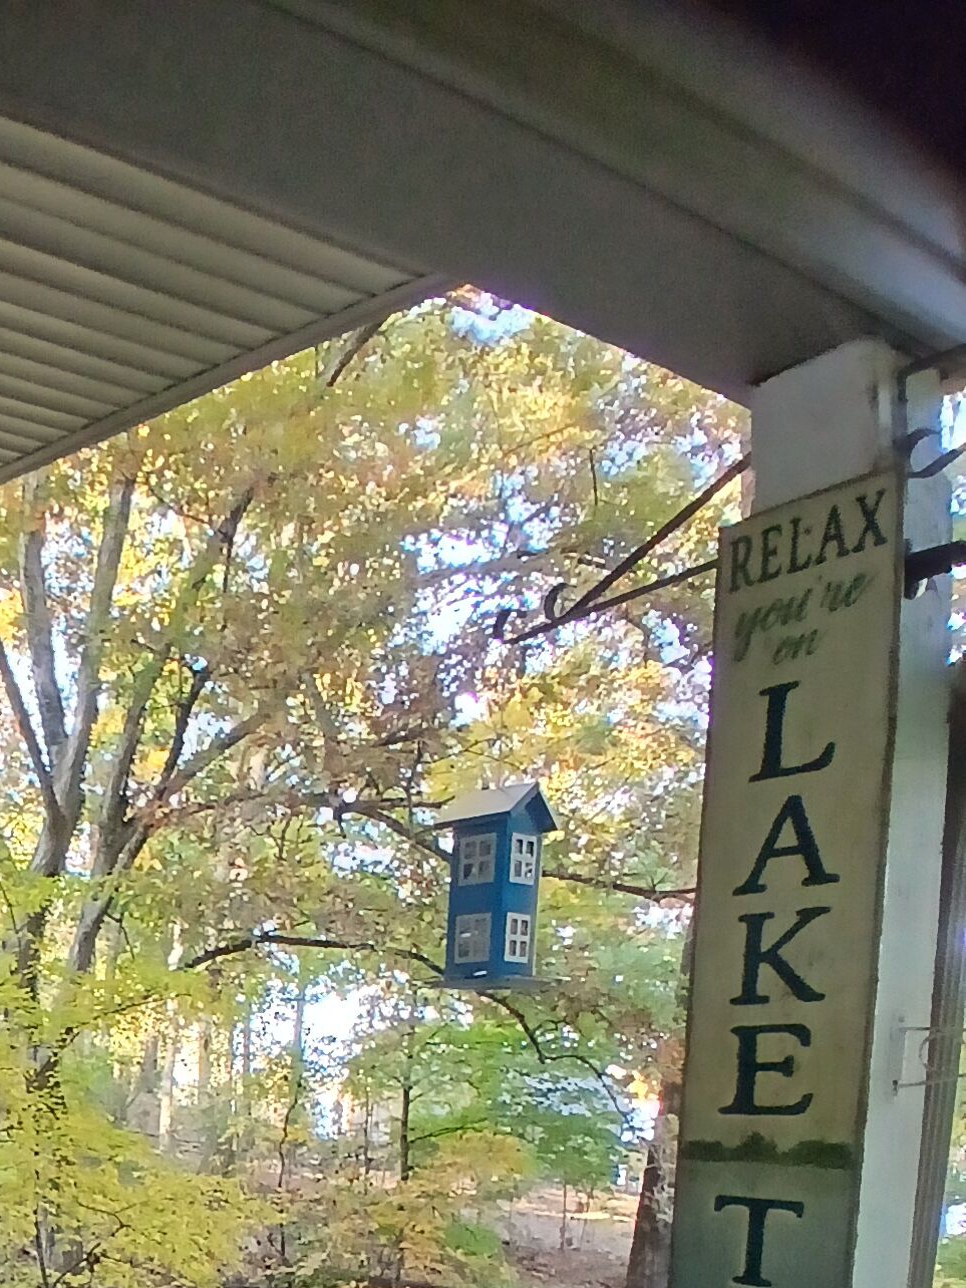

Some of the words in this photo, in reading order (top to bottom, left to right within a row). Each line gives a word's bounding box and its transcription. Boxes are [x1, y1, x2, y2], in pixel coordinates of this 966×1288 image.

[728, 488, 888, 593] RELAX
[733, 572, 872, 663] you're
[772, 628, 822, 665] on
[717, 680, 841, 1116] LAKE
